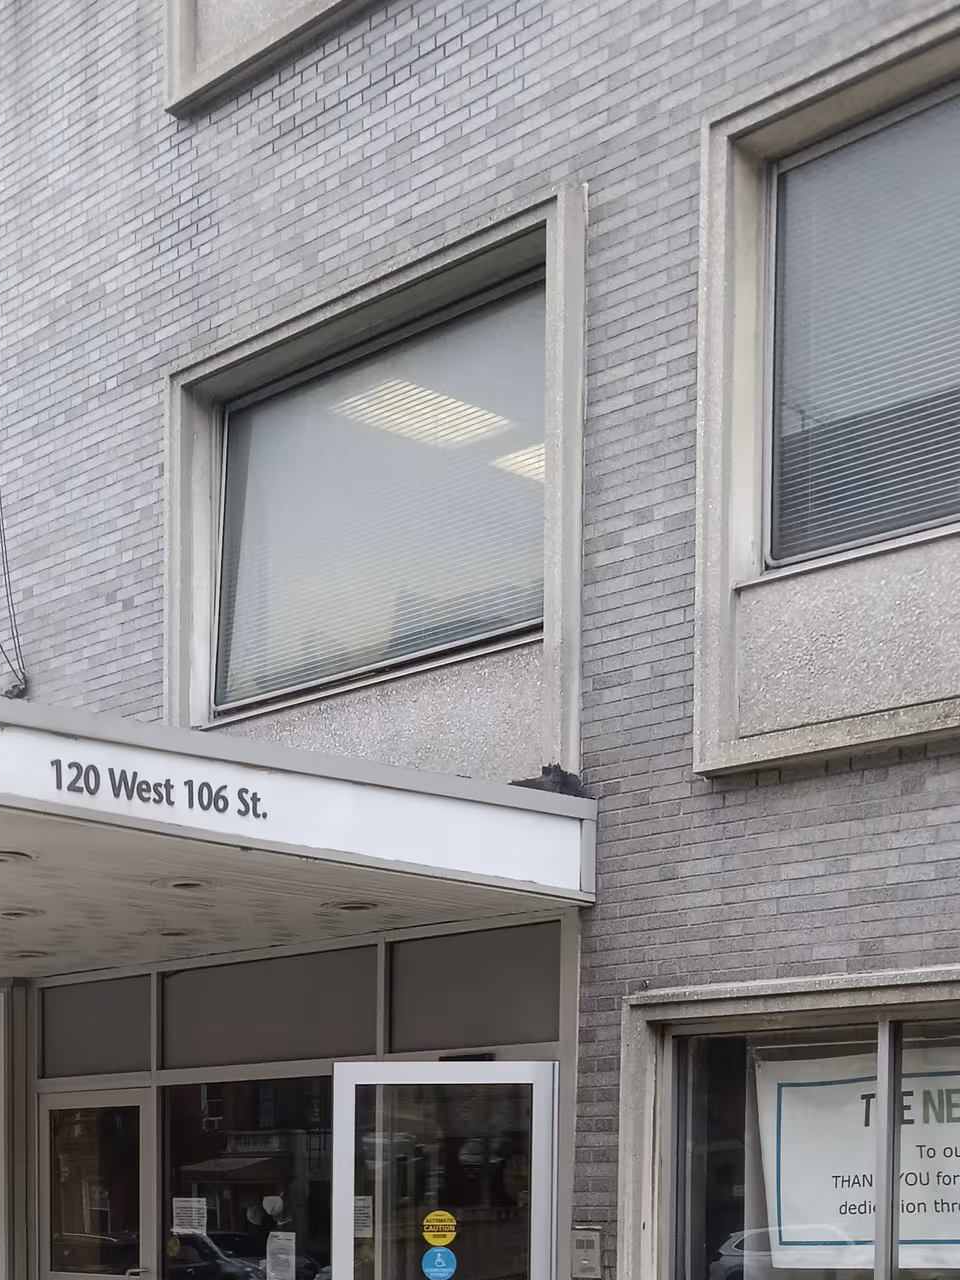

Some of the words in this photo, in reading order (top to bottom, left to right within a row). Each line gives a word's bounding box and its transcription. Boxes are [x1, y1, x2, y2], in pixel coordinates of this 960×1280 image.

[50, 759, 100, 796] 120
[108, 767, 175, 806] West
[184, 779, 229, 813] 106
[237, 787, 268, 819] St.
[861, 1090, 915, 1127] TE
[916, 1144, 936, 1158] To
[832, 1174, 874, 1189] THAN
[936, 1171, 960, 1186] for
[839, 1199, 927, 1215] dediion
[934, 1199, 960, 1213] thr
